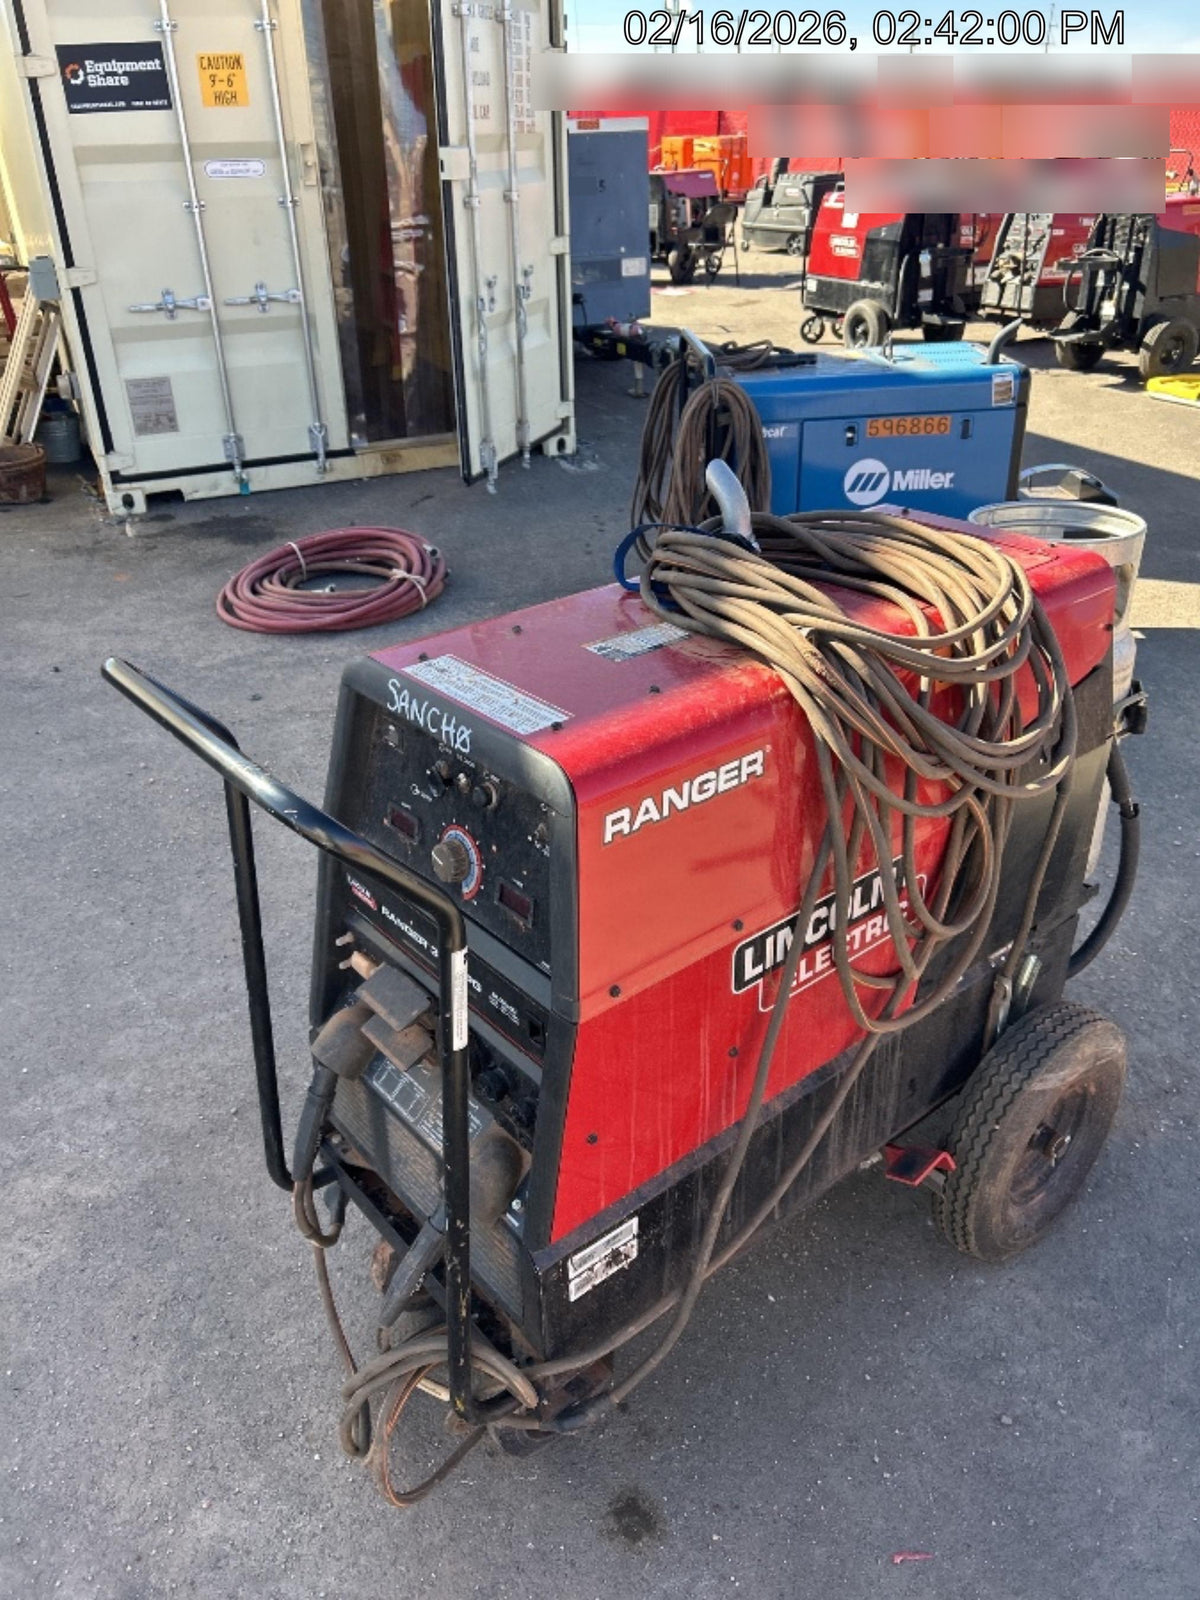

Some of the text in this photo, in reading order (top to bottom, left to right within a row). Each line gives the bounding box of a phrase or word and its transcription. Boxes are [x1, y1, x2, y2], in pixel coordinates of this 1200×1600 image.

[85, 58, 162, 75] Equipment
[200, 55, 242, 70] CAUTION
[87, 75, 130, 87] Share
[214, 90, 238, 105] HIGH
[868, 416, 949, 436] 596866
[892, 470, 955, 491] Miller
[603, 749, 765, 844] RANGER
[789, 901, 909, 988] LETRI
